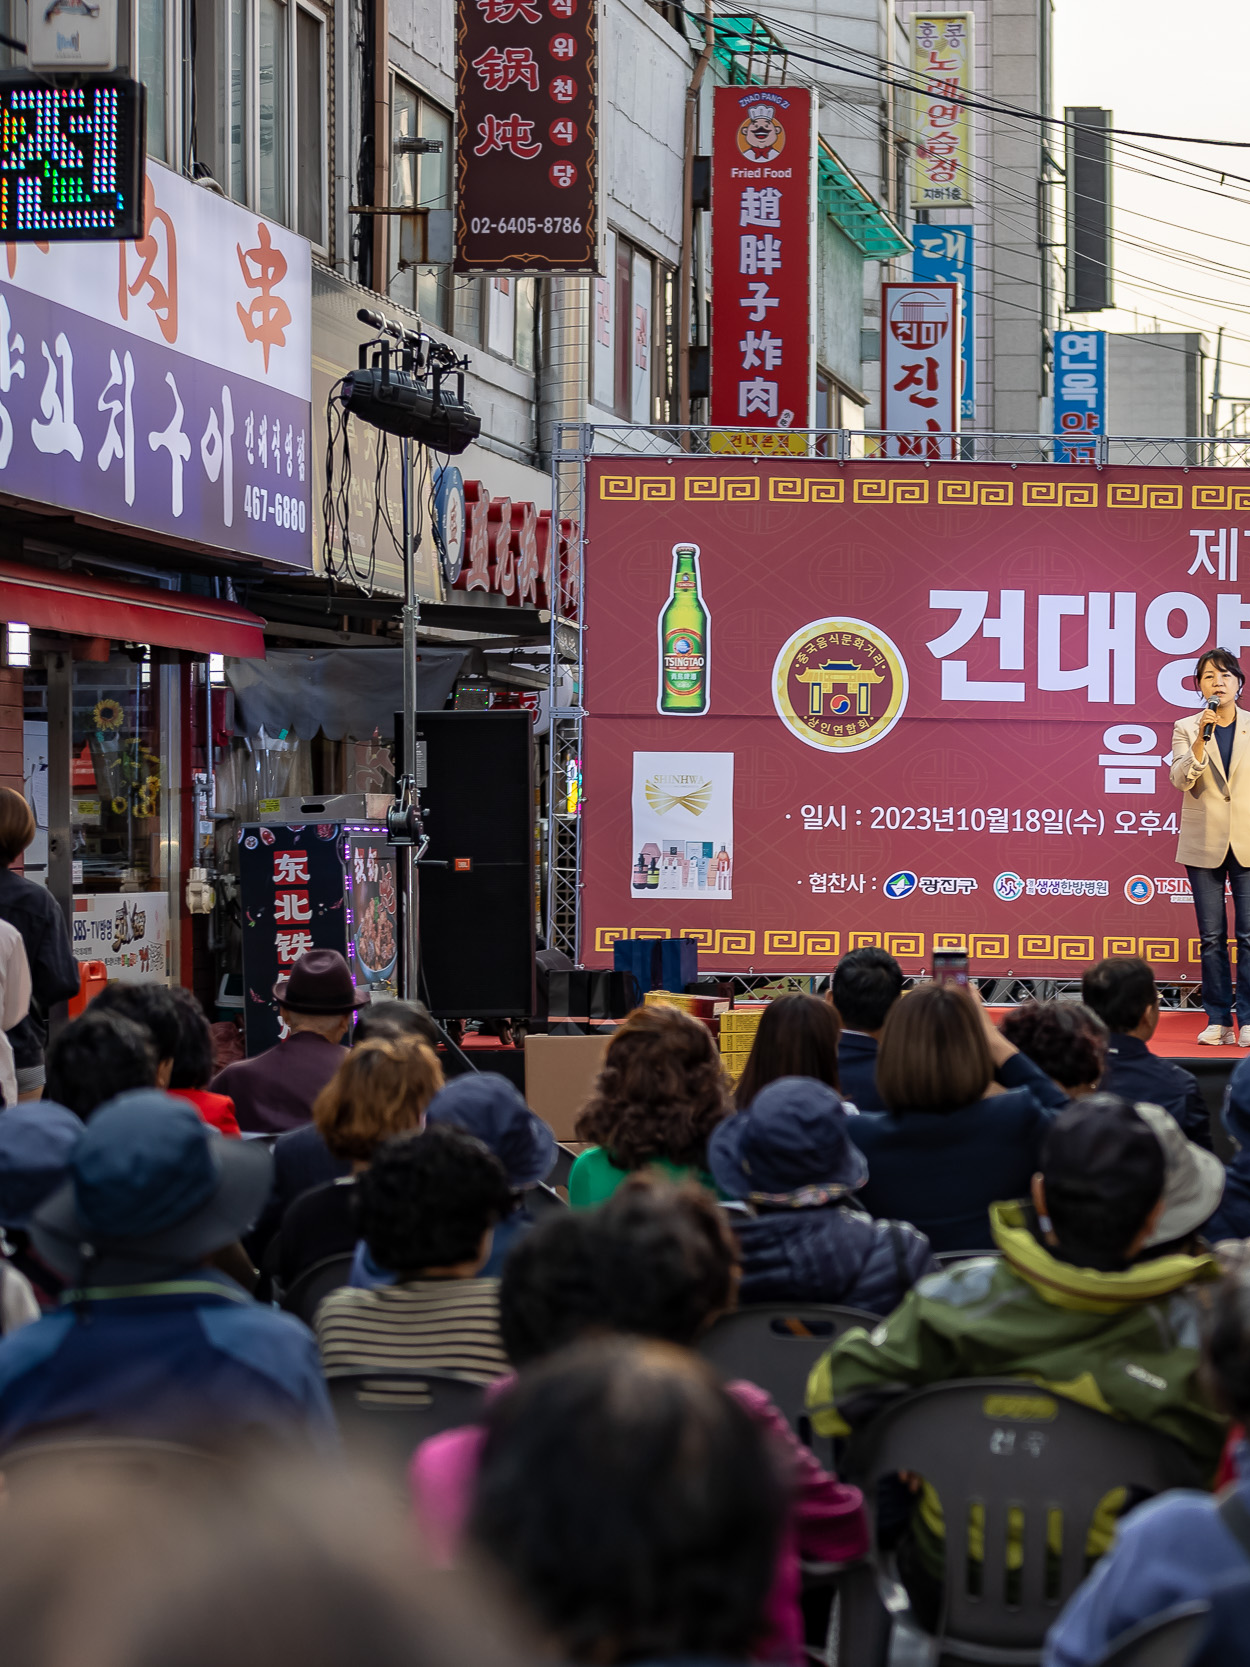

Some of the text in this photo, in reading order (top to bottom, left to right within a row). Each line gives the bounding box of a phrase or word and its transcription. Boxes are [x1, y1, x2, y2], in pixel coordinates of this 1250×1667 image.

[916, 22, 966, 49] 홍콩
[738, 92, 791, 109] ZHAO PANG ZI
[925, 51, 962, 183] 노래연습장
[731, 168, 792, 178] Fried Food
[924, 187, 962, 201] 지하1층
[471, 217, 582, 234] 02-6405-8786
[738, 186, 783, 419] 趙胖子炸肉
[897, 323, 944, 344] 진미
[0, 293, 235, 528] 꼬치구이
[244, 485, 306, 533] 467-6880
[796, 633, 886, 667] 중국음식문화거리
[664, 657, 705, 667] TSINGTAO
[807, 716, 870, 736] 상인연합회
[1098, 724, 1173, 794] 음
[653, 774, 706, 784] SHINHWA
[800, 804, 846, 831] 일시
[870, 806, 1105, 836] 2023년10월18일(수)
[1114, 810, 1184, 837] 오후4
[809, 872, 867, 894] 협찬사
[920, 877, 978, 895] 광진구
[1036, 879, 1108, 895] 생생한방병원
